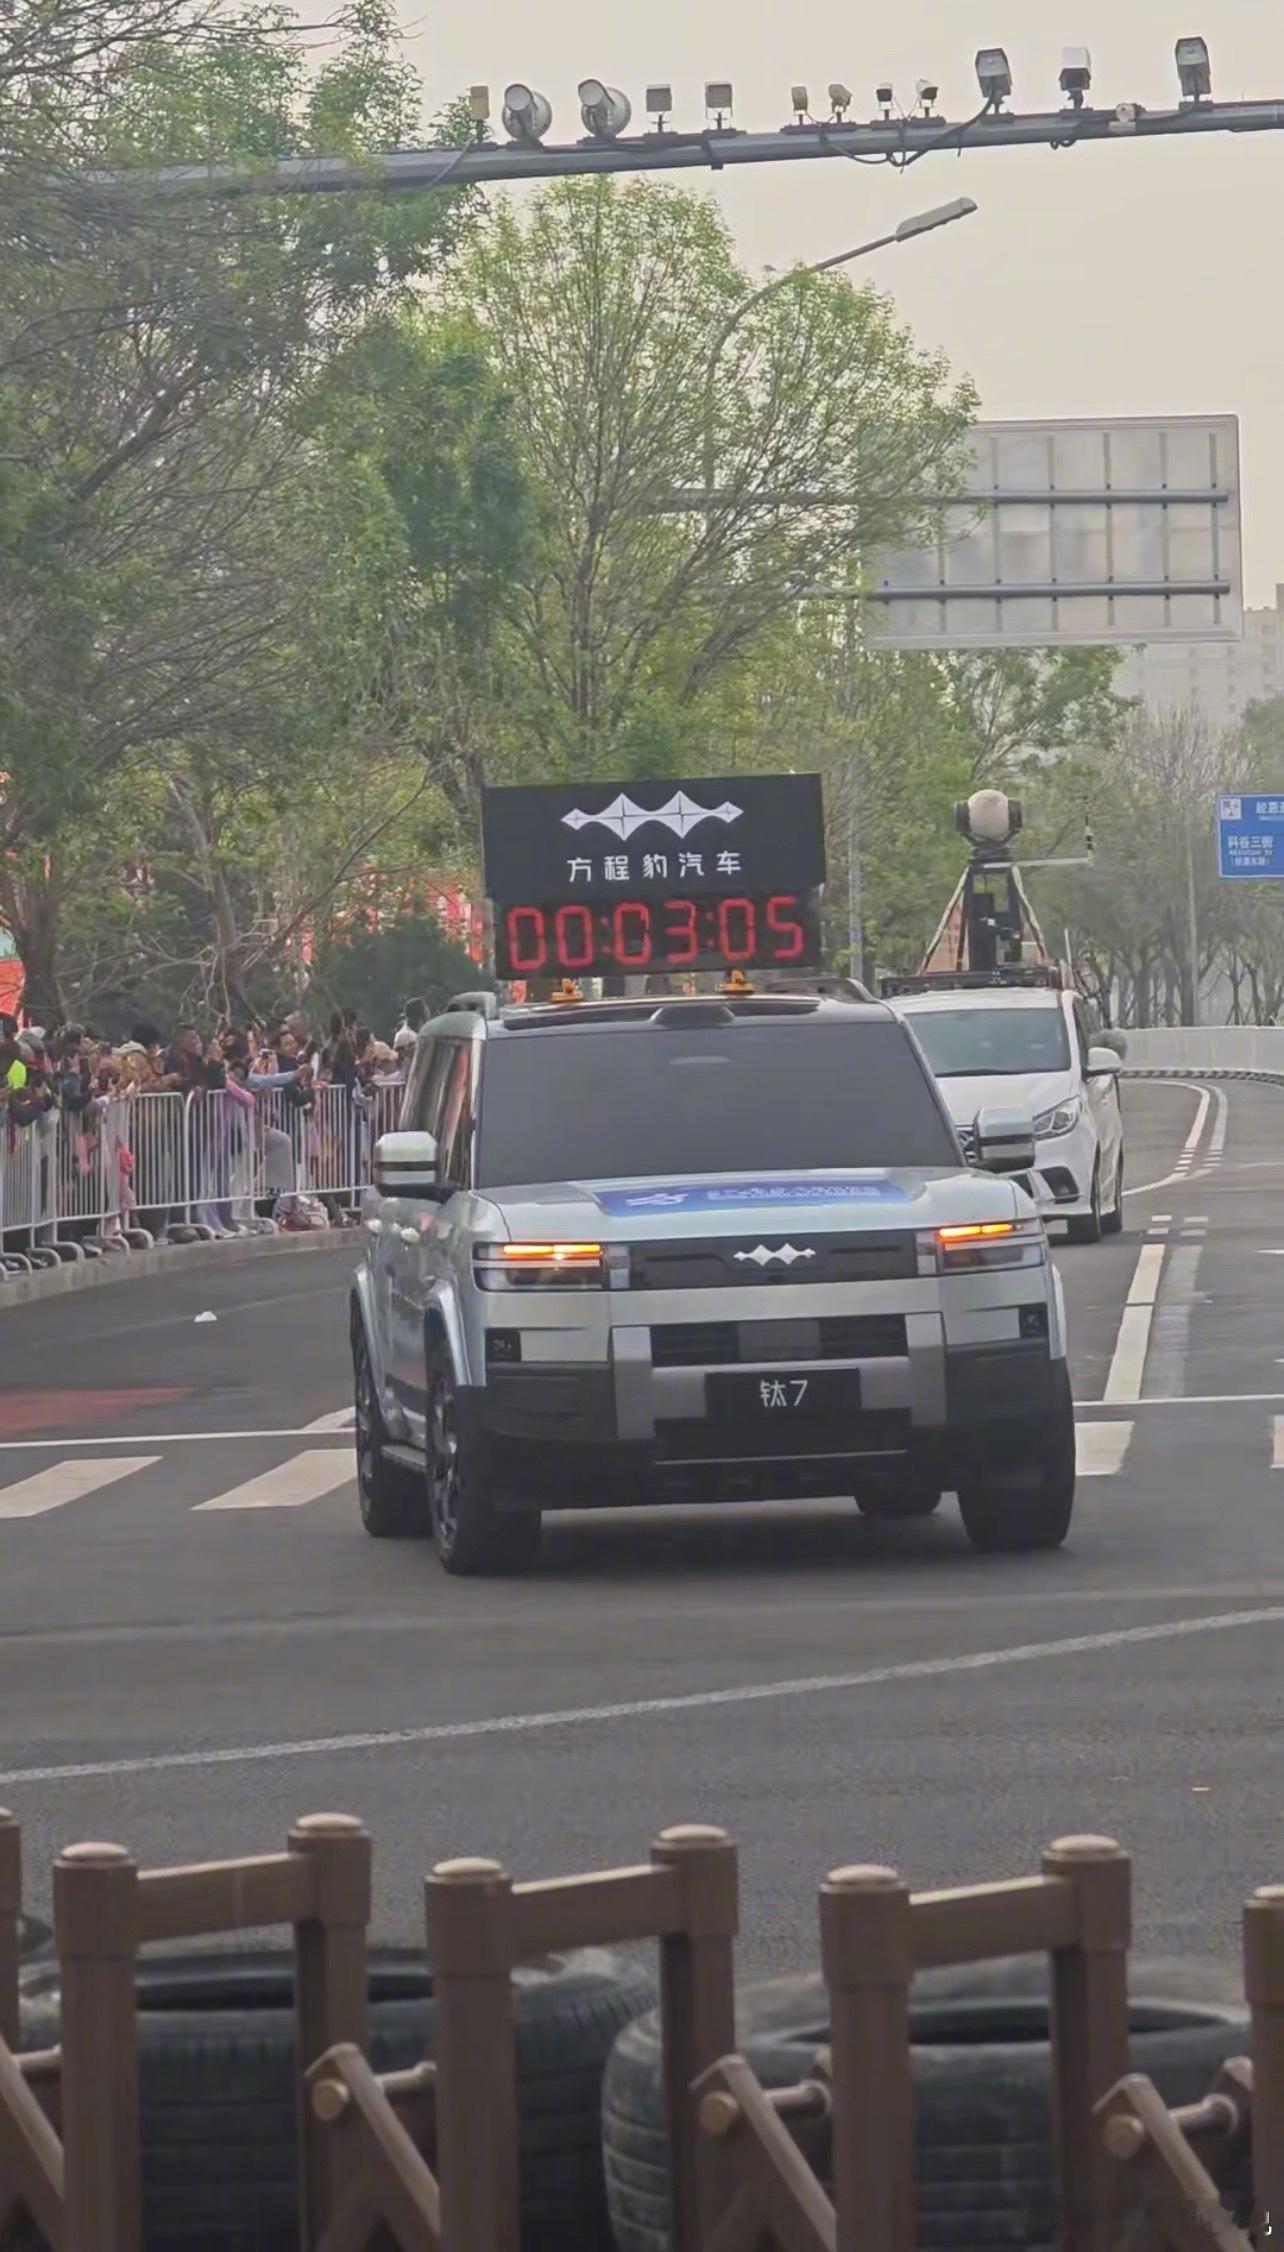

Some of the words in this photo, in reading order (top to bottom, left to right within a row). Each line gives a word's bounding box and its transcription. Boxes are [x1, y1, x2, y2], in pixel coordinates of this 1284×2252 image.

[567, 851, 742, 883] 方程豹汽车
[508, 896, 804, 970] 00:03:05
[760, 1379, 808, 1407] 钛7
